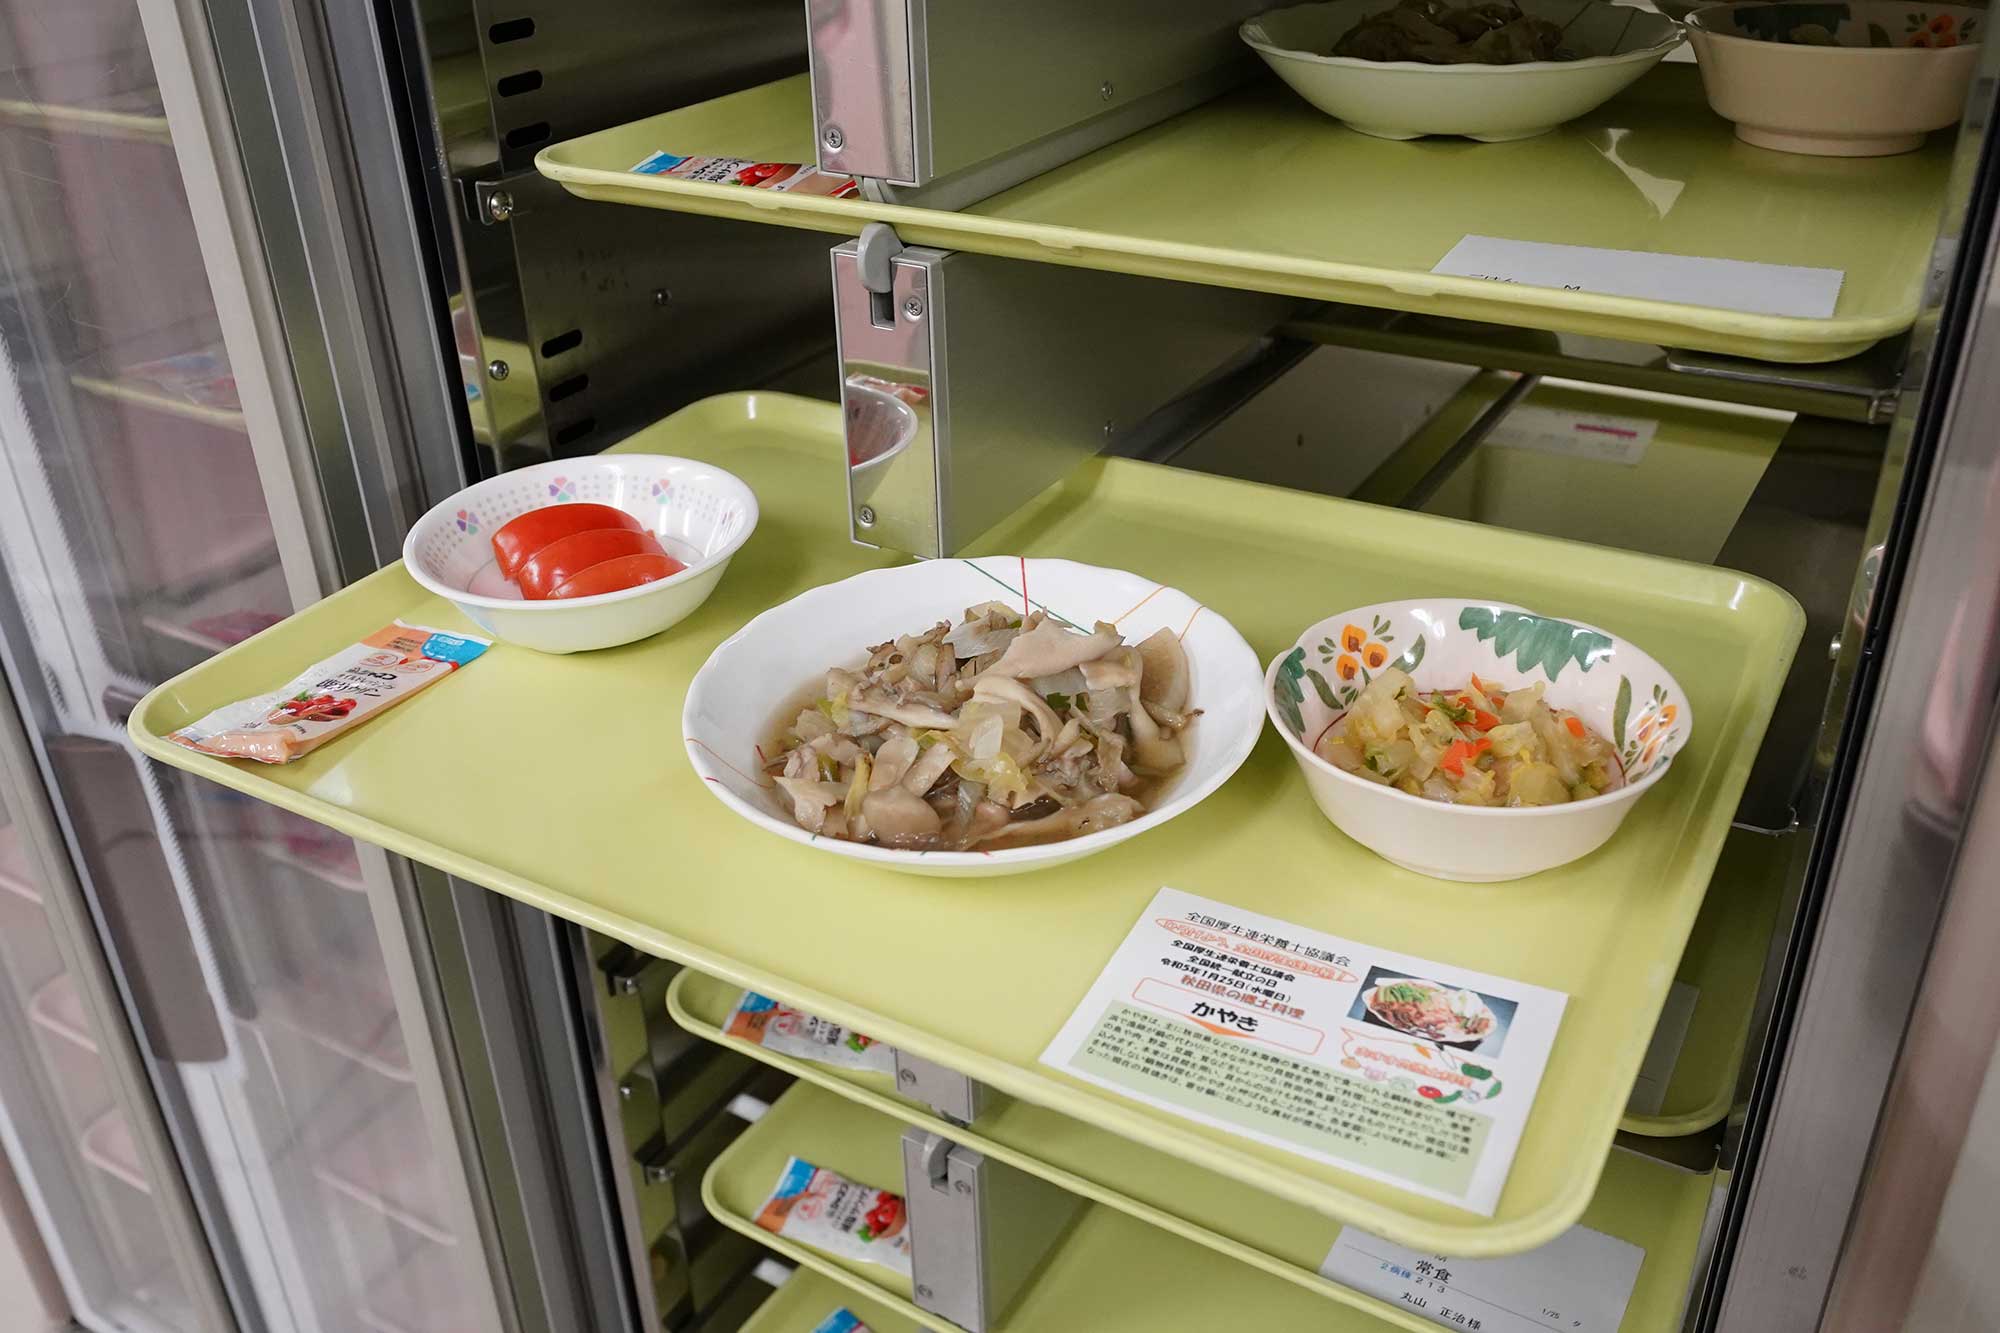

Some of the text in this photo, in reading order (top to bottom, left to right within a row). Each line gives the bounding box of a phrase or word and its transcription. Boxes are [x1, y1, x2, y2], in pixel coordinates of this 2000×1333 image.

[1183, 910, 1352, 968] 全国厚生連栄養士協議会
[1185, 954, 1279, 988] 全国統一献立の日
[1179, 974, 1306, 1020] 秋田県の郷土料理
[1188, 999, 1261, 1033] かやき
[1416, 1260, 1452, 1284] 常食
[1400, 1292, 1482, 1331] 丸山 正治様
